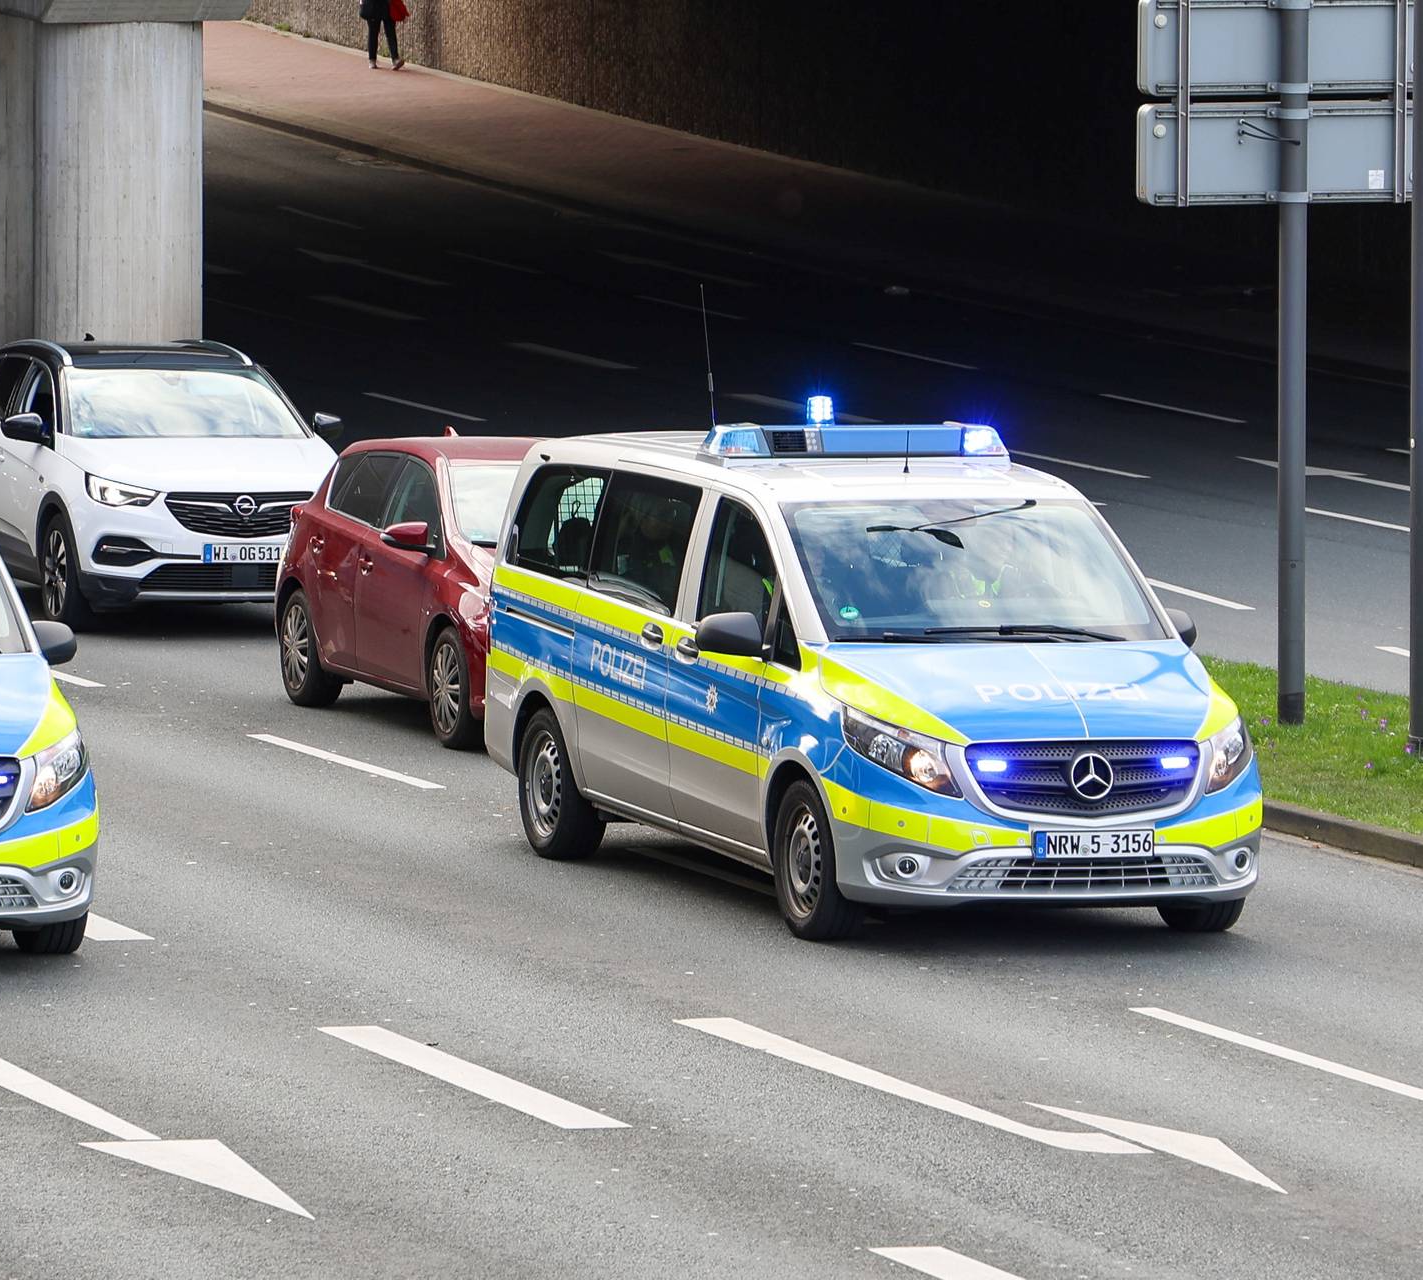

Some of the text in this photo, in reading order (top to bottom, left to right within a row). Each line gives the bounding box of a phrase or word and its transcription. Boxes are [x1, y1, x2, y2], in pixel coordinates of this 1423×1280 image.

[214, 546, 283, 561] WI OG 511
[590, 639, 647, 690] POLIZEI
[974, 682, 1148, 703] POLIZEI
[1047, 834, 1081, 855] NRW
[1091, 833, 1152, 854] 5-3156
